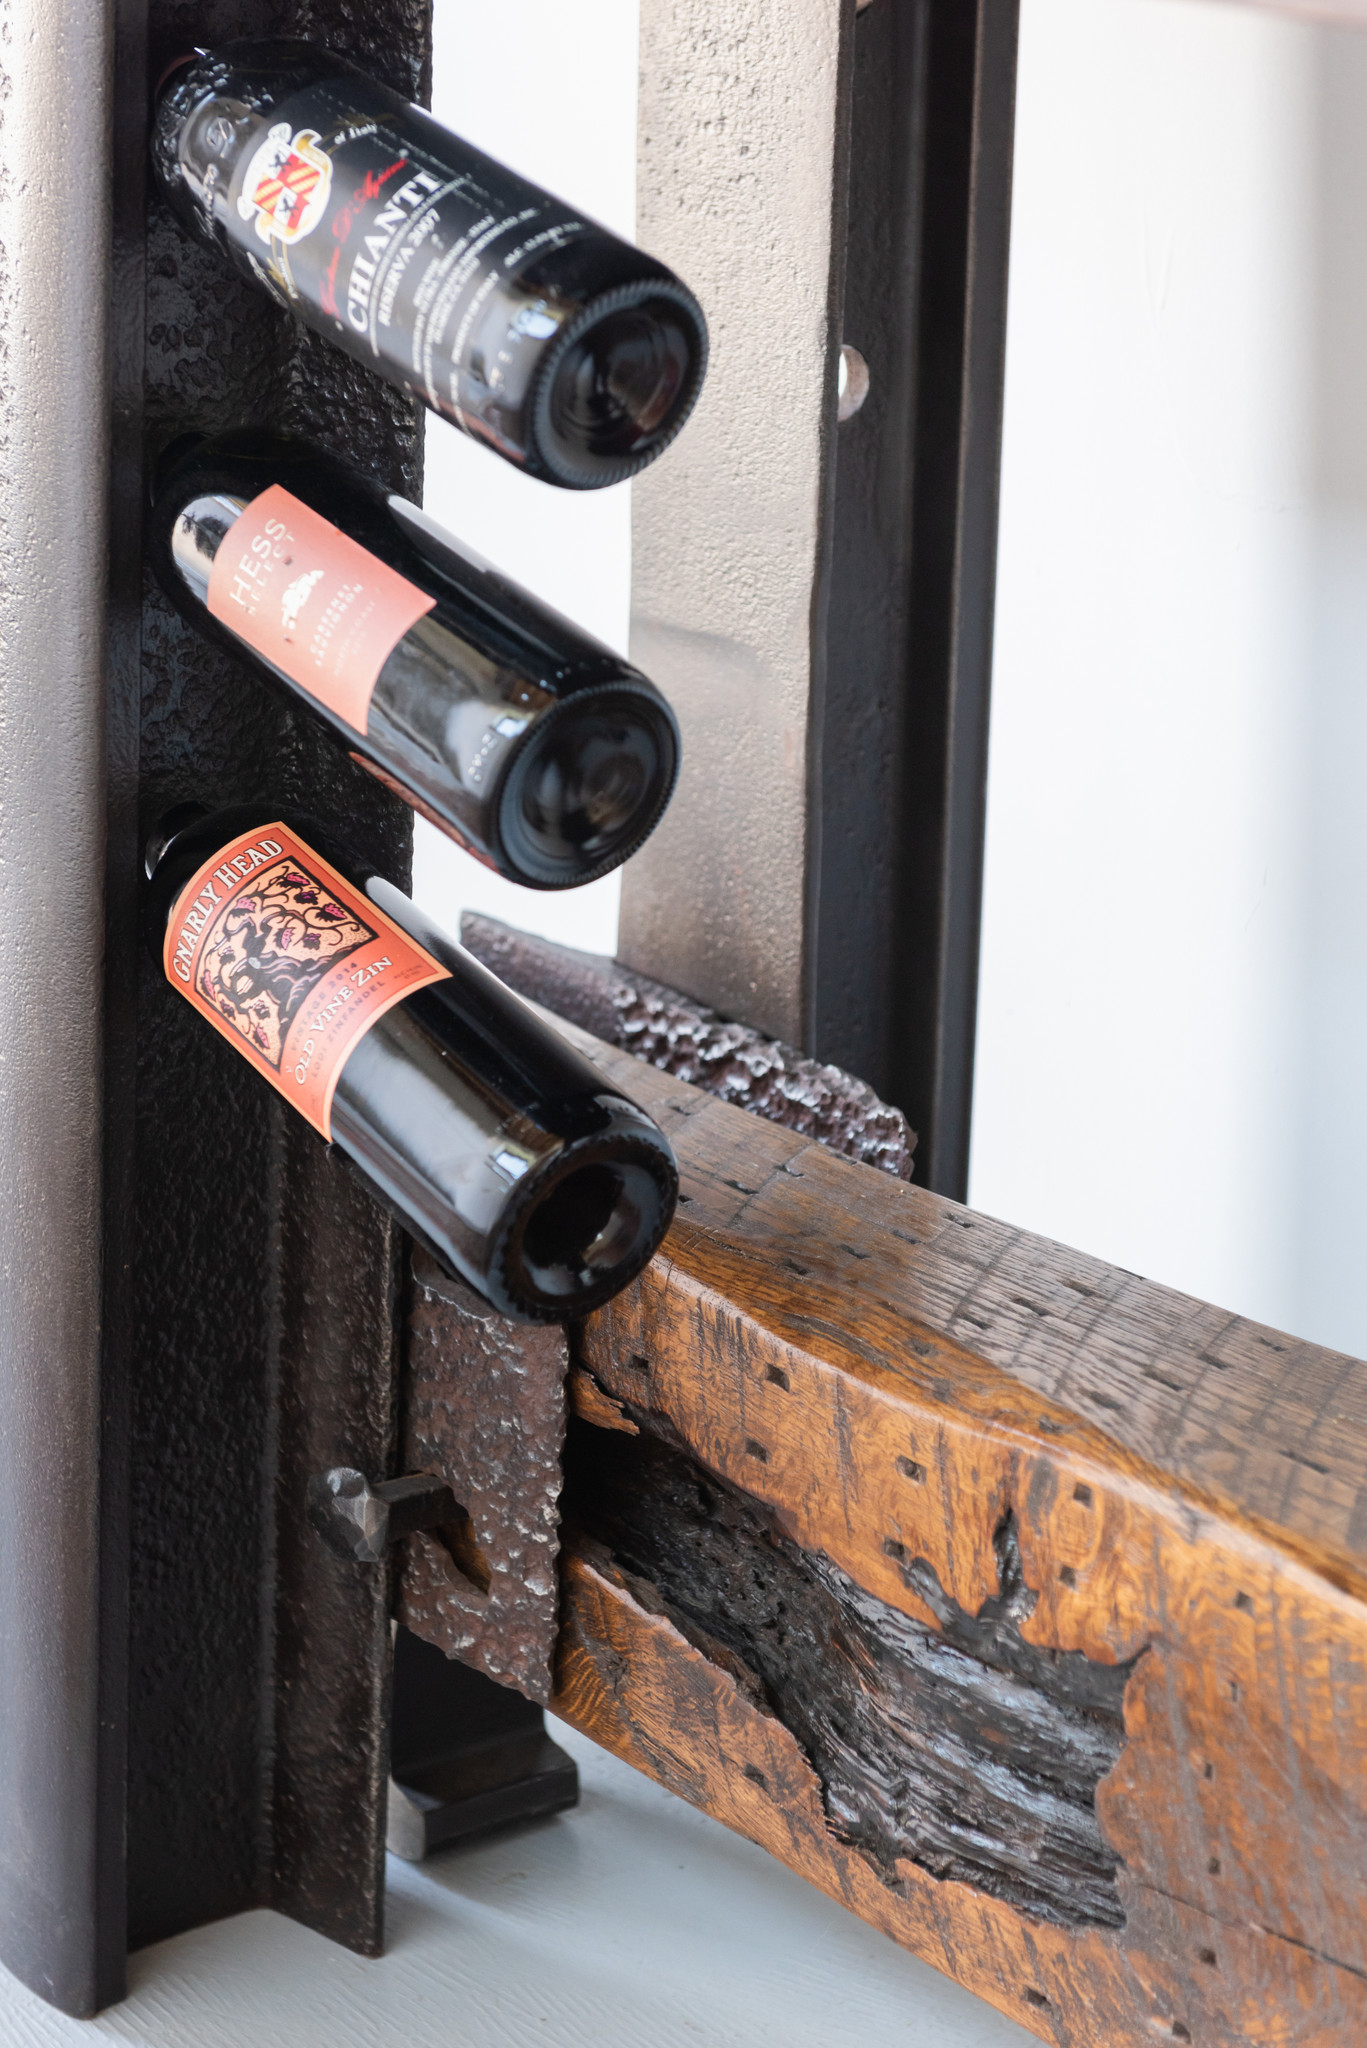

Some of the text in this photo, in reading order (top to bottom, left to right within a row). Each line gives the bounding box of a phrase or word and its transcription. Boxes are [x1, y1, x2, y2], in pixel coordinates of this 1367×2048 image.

[347, 171, 441, 333] CHIANTI
[378, 247, 415, 327] RISERVA
[407, 208, 440, 247] 2007
[229, 518, 286, 605] HESS
[310, 583, 350, 653] CABERNET
[315, 583, 363, 667] SAUVIGNON
[173, 839, 284, 982] GNARLY HEAD
[291, 962, 357, 1051] VINTAGE 2014
[295, 956, 393, 1085] OLD VINE ZIN
[328, 981, 385, 1042] ZINFANDEL
